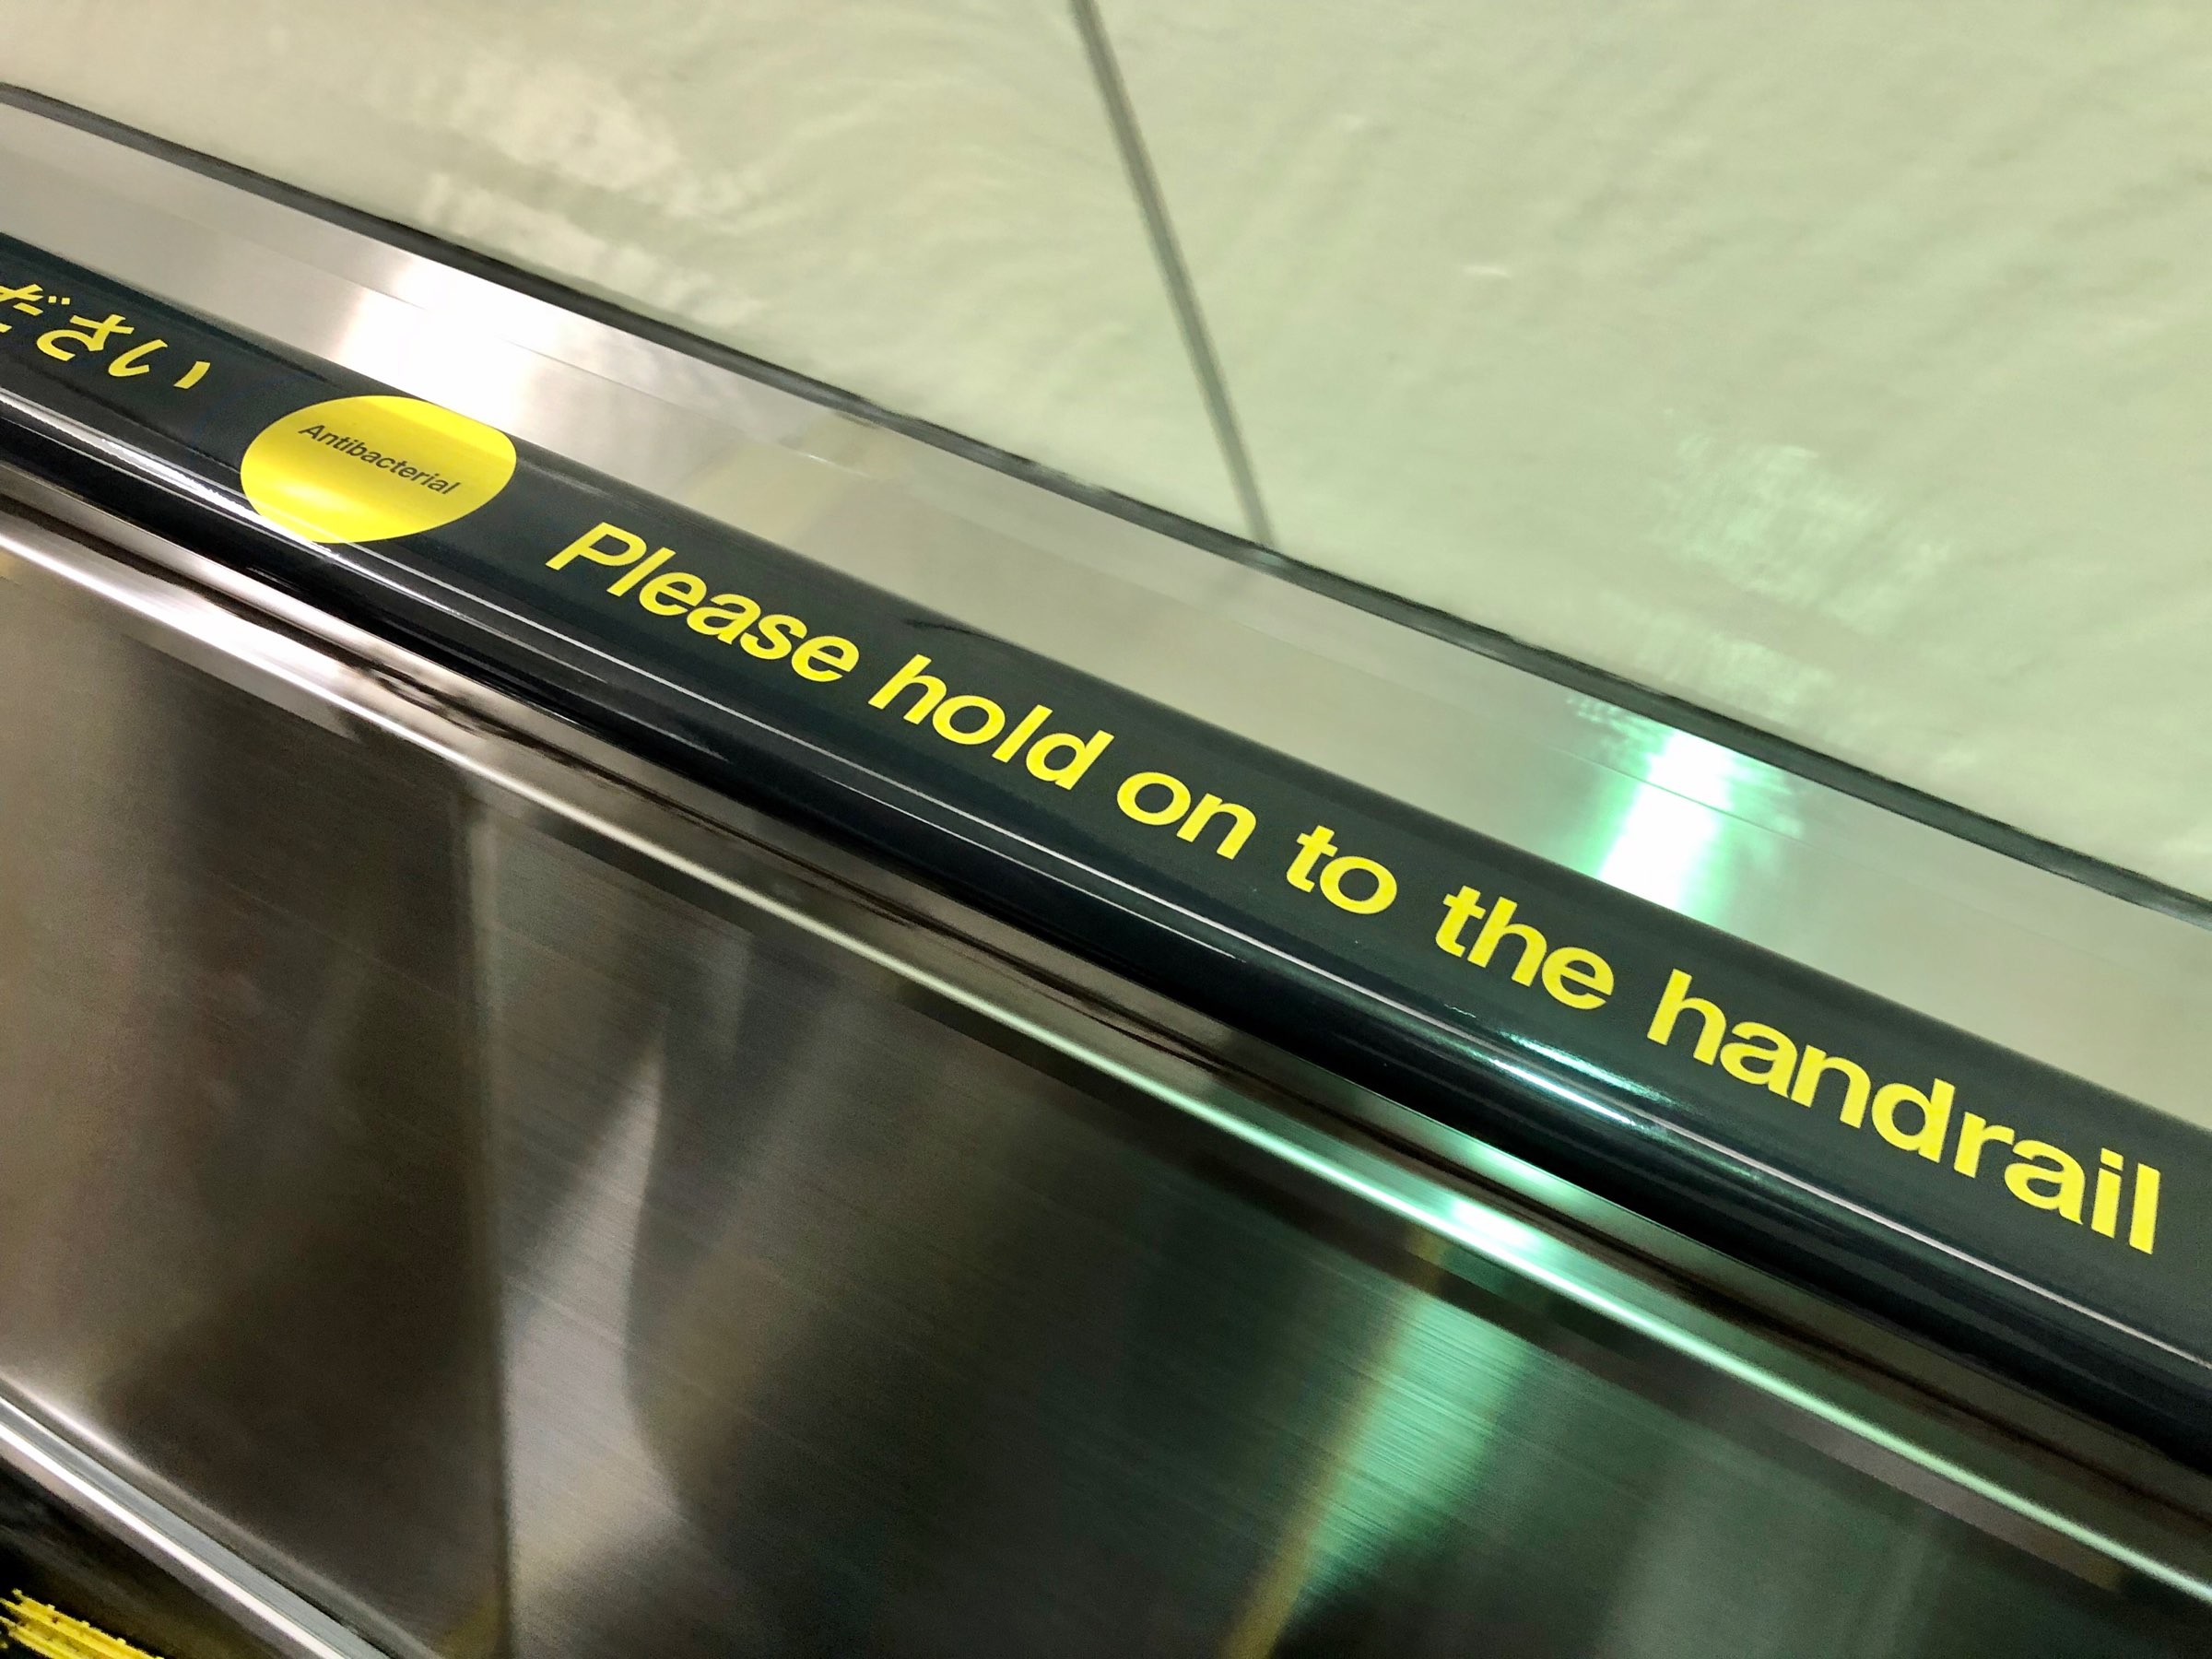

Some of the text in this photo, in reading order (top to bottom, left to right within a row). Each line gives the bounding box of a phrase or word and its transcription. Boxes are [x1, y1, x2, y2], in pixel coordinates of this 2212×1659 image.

[298, 424, 461, 495] Antibacterial
[546, 522, 2162, 1253] Please hold on to the handrail
